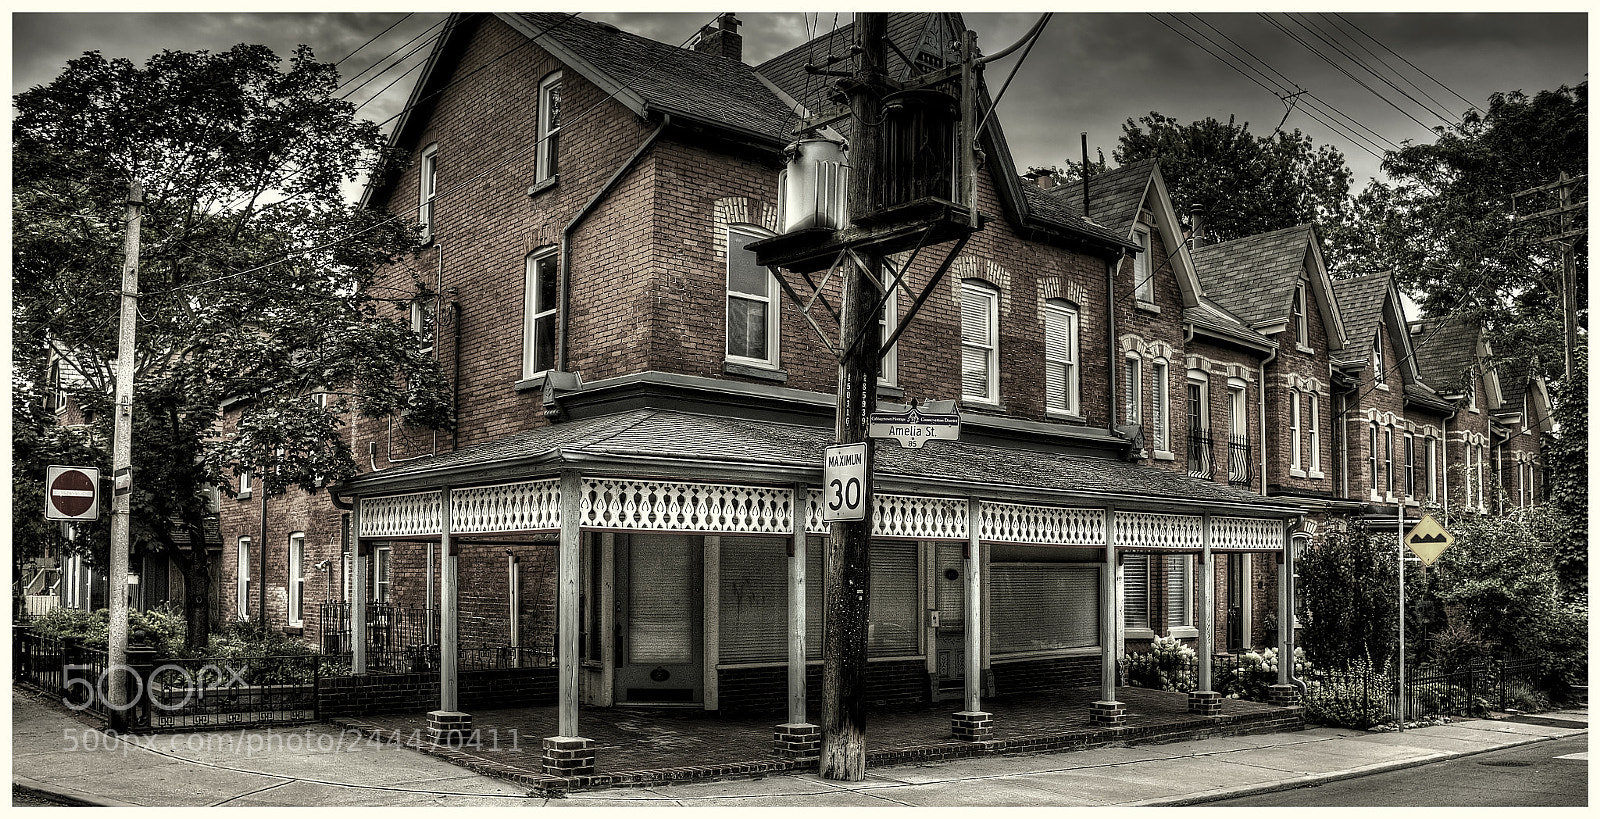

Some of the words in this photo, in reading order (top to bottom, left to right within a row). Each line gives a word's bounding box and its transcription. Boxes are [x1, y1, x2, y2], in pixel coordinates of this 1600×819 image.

[889, 425, 922, 437] Amelia
[925, 426, 937, 437] St.
[828, 453, 862, 468] MAXIMUM
[829, 477, 861, 511] 30
